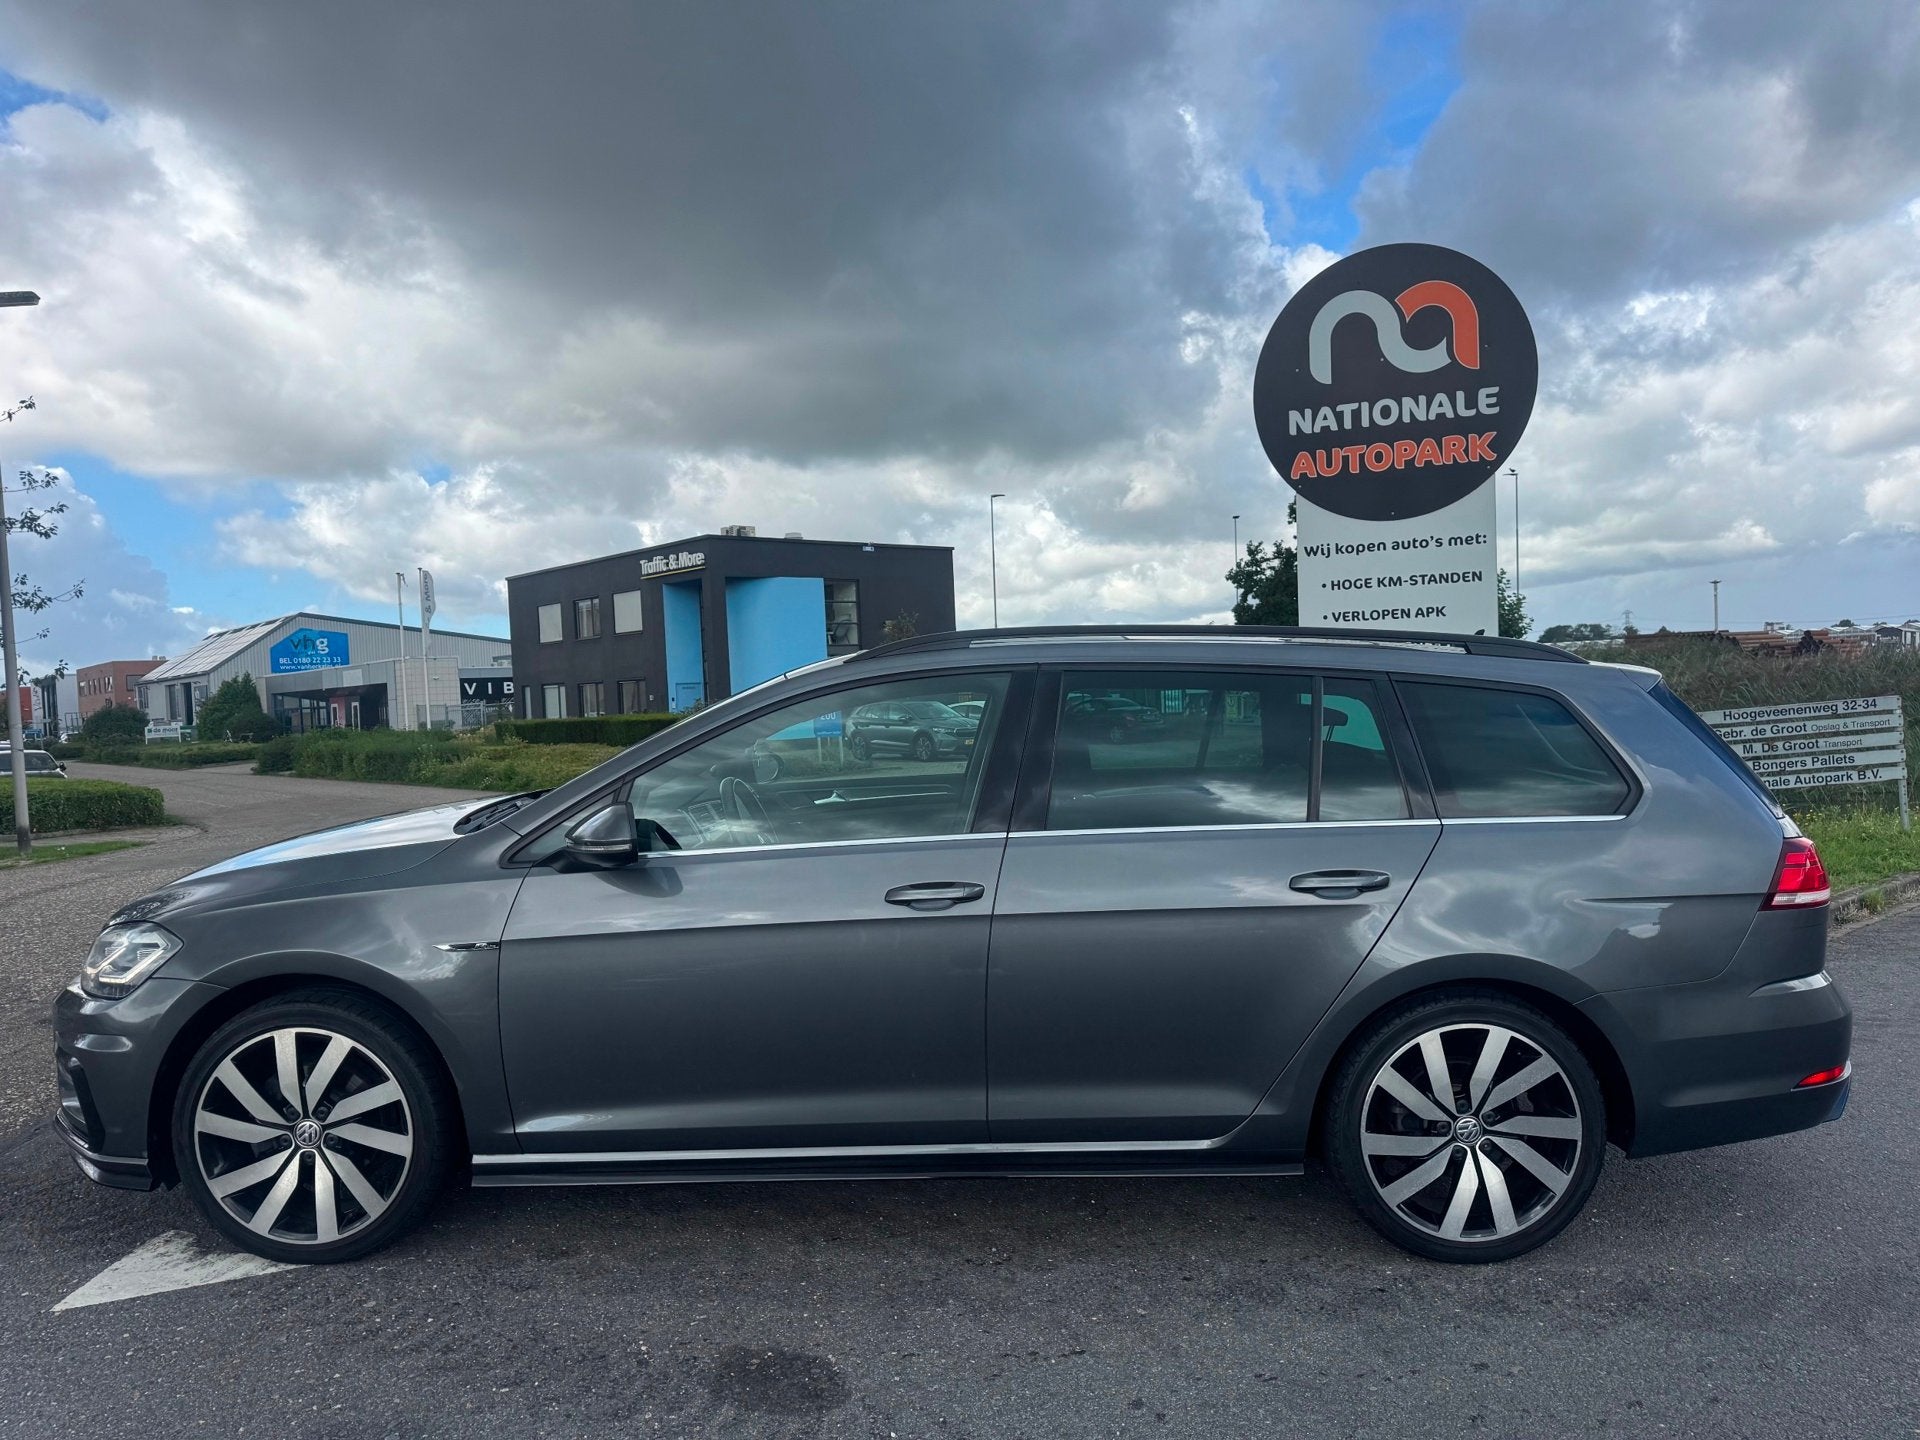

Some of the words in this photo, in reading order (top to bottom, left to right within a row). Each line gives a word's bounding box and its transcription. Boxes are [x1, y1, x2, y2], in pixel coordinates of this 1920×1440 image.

[1288, 386, 1500, 436] NATIONALE
[1290, 431, 1498, 480] AUTOPARK
[1304, 543, 1331, 558] Wij
[1335, 540, 1387, 556] kopen
[1391, 535, 1443, 551] auto's
[1448, 533, 1487, 547] met:
[640, 556, 669, 575] Traffic
[668, 554, 678, 570] &
[678, 551, 705, 568] More
[1331, 577, 1373, 591] HOGE
[1377, 570, 1483, 588] KM-STANDEN
[1332, 607, 1411, 623] VERLOPEN
[1414, 605, 1447, 618] APK
[289, 634, 329, 655] vhg
[1723, 704, 1838, 721] Hoogeveenenweg
[1842, 698, 1877, 711] 32-34
[1750, 726, 1767, 737] de
[1770, 723, 1807, 735] Groot
[1811, 723, 1840, 732] Opslag
[1842, 721, 1849, 729] &
[1851, 719, 1891, 729] Transport
[1742, 744, 1757, 755] M.
[1762, 742, 1779, 753] De
[1782, 739, 1819, 751] Groot
[1824, 738, 1862, 748] Transport
[1752, 759, 1807, 772] Bongers
[1811, 755, 1855, 767] Pallets
[1793, 771, 1853, 786] Autopark
[1857, 769, 1882, 780] B.V.
